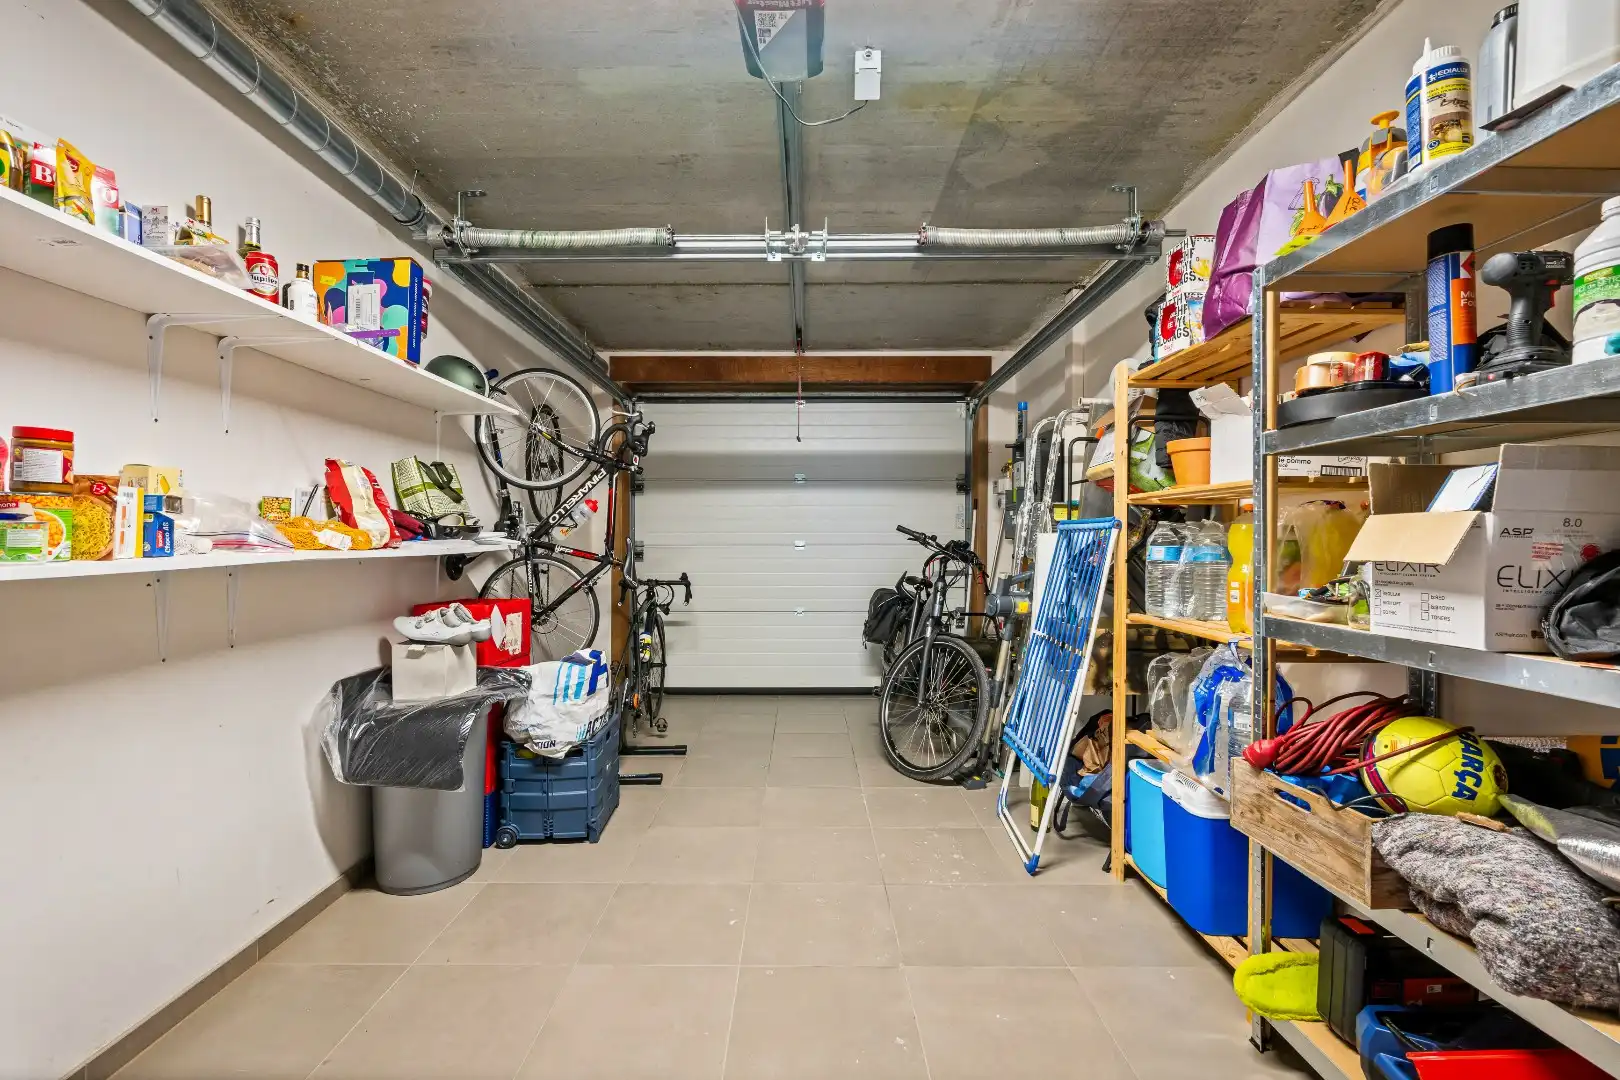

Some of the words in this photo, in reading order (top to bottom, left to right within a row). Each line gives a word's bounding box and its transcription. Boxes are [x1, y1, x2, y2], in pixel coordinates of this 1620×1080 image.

[1437, 67, 1468, 76] EDIALUX
[549, 467, 607, 524] PINARELLO
[1562, 517, 1583, 528] 8.0
[1497, 565, 1574, 589] ELIX
[536, 740, 556, 749] TION
[1451, 732, 1484, 801] BARÇA
